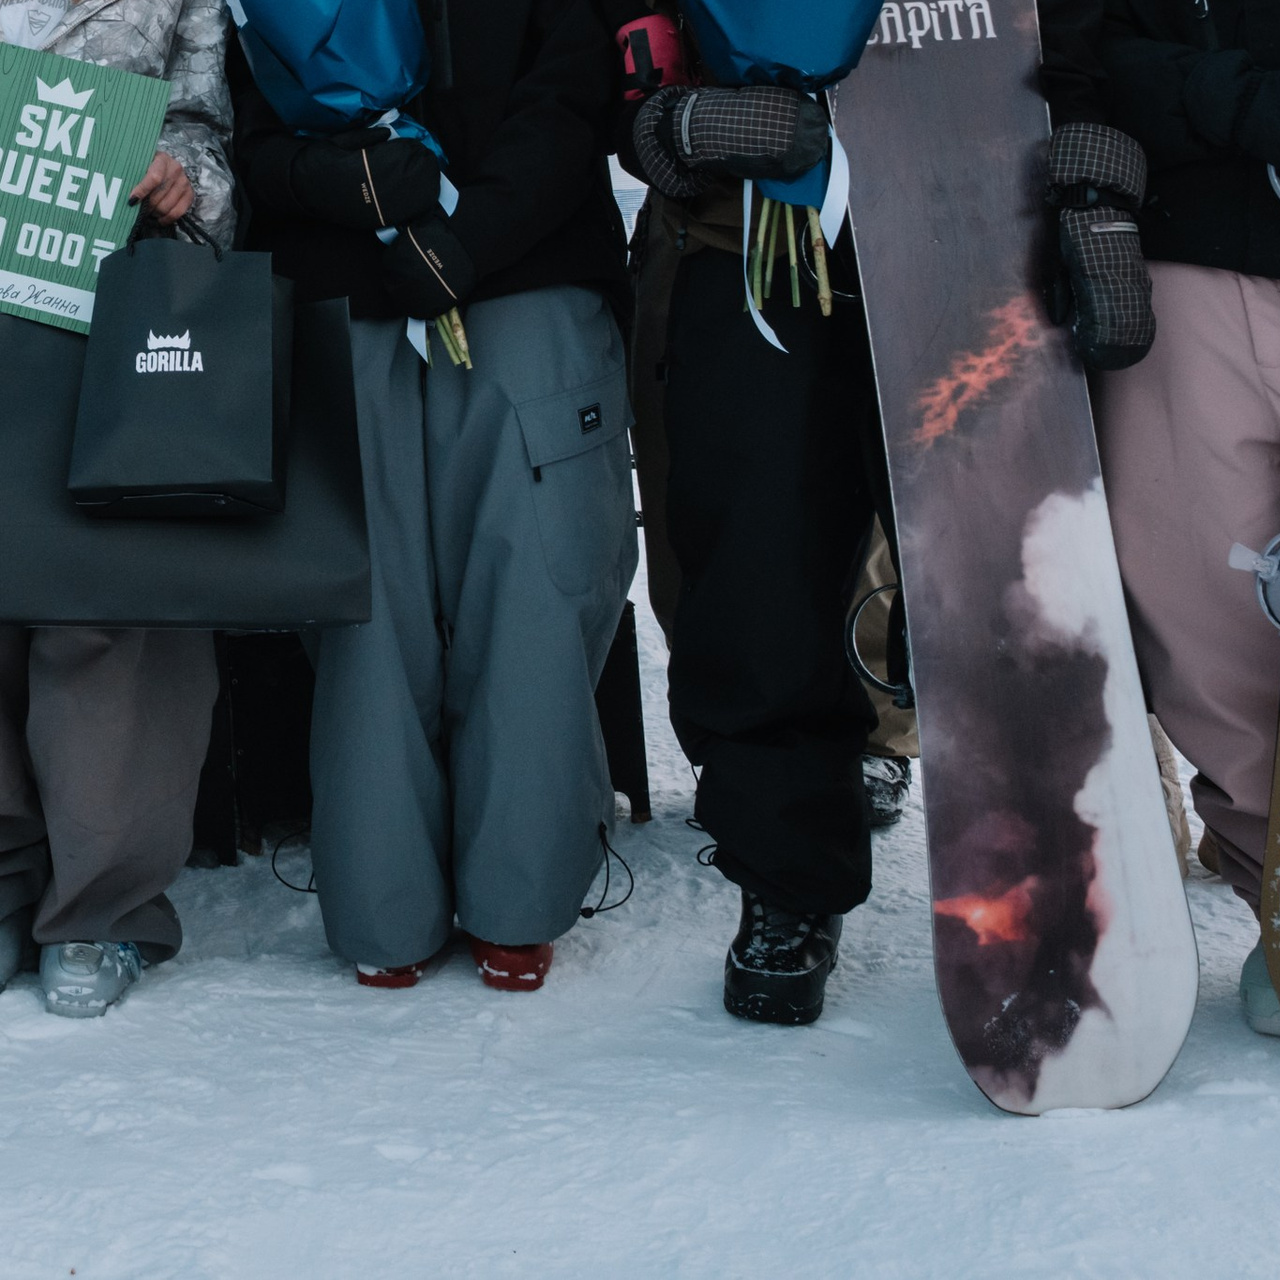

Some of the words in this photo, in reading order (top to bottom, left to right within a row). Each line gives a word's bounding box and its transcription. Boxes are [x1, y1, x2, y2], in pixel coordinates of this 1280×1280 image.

[14, 104, 95, 159] SKI
[360, 182, 371, 204] WEDZE
[21, 283, 81, 316] Жанна
[135, 351, 204, 373] GORILLA
